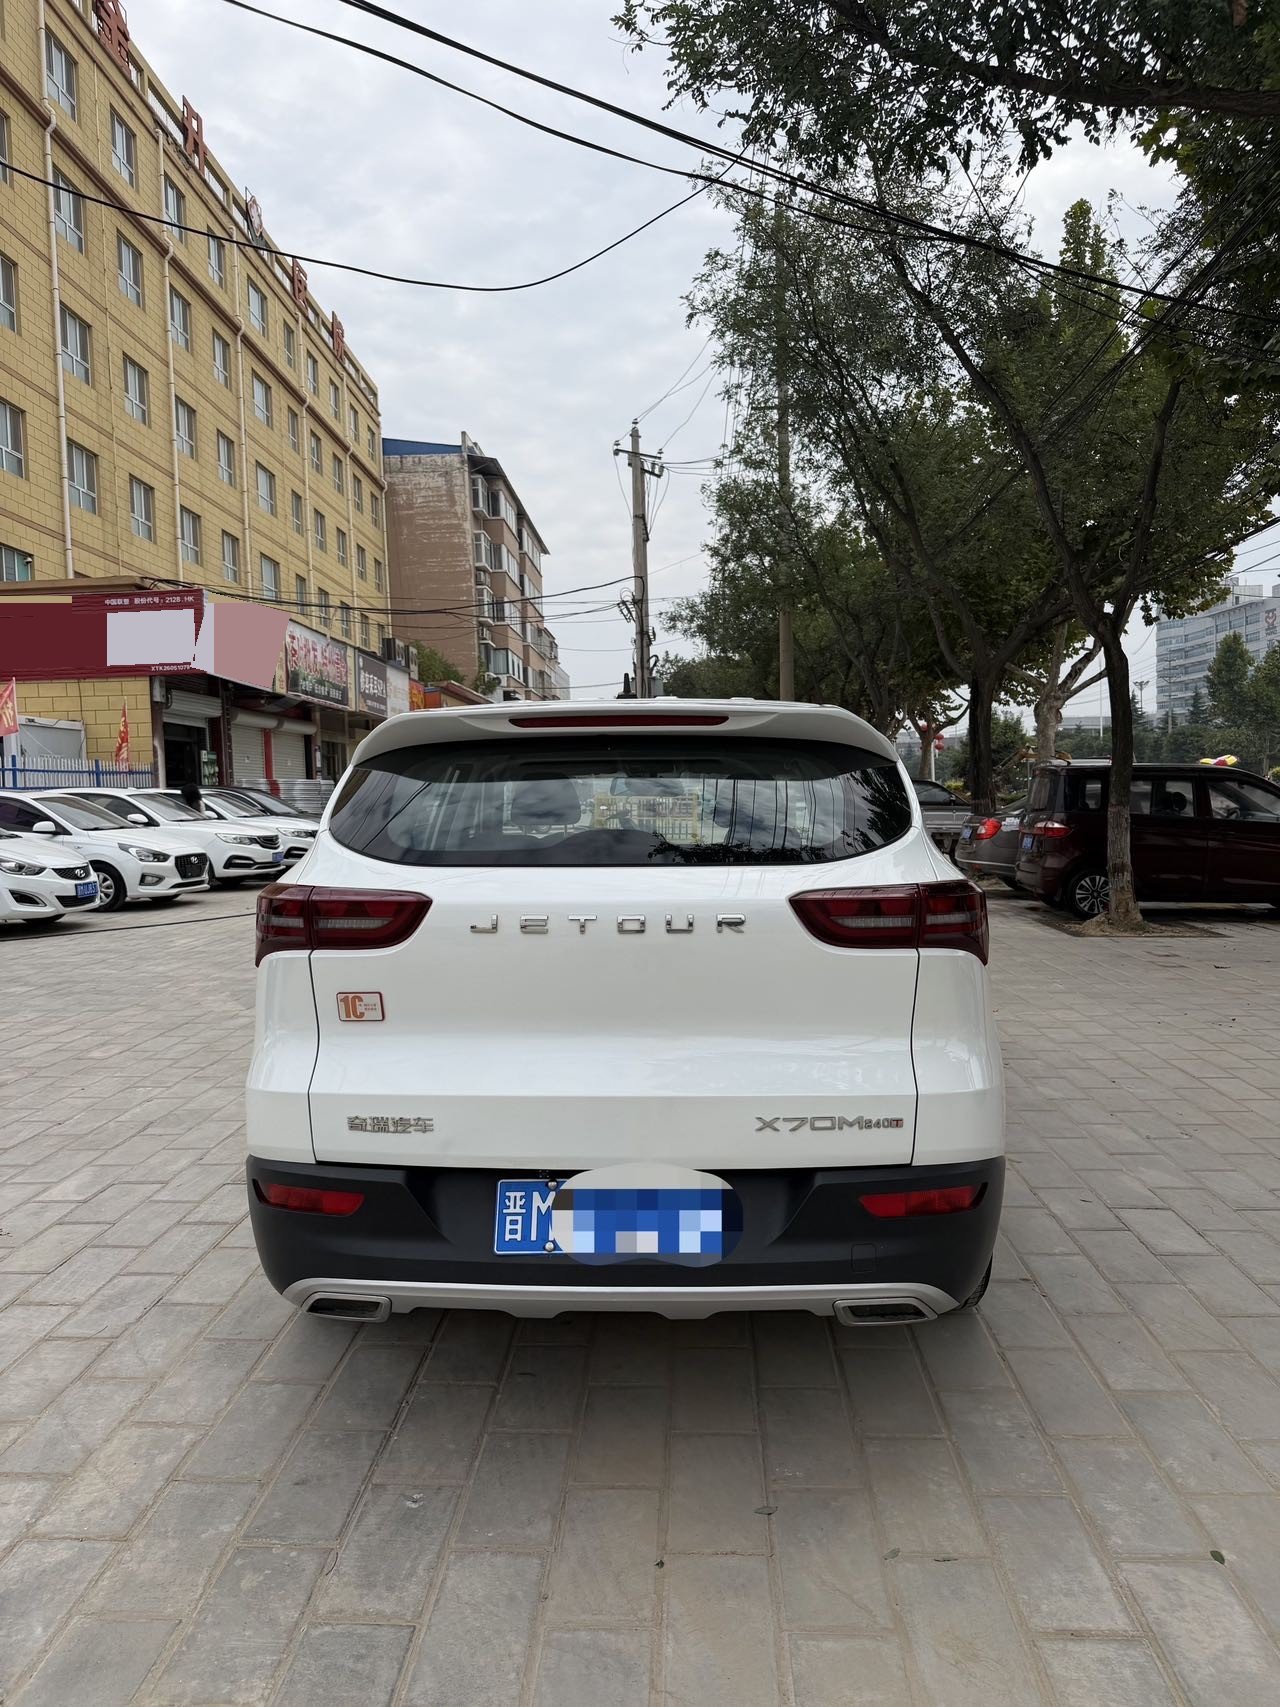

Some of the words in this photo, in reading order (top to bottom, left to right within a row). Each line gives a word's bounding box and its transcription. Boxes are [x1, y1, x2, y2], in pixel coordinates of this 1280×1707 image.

[470, 913, 746, 935] JETOUR
[347, 1115, 434, 1134] 奇瑞汽车
